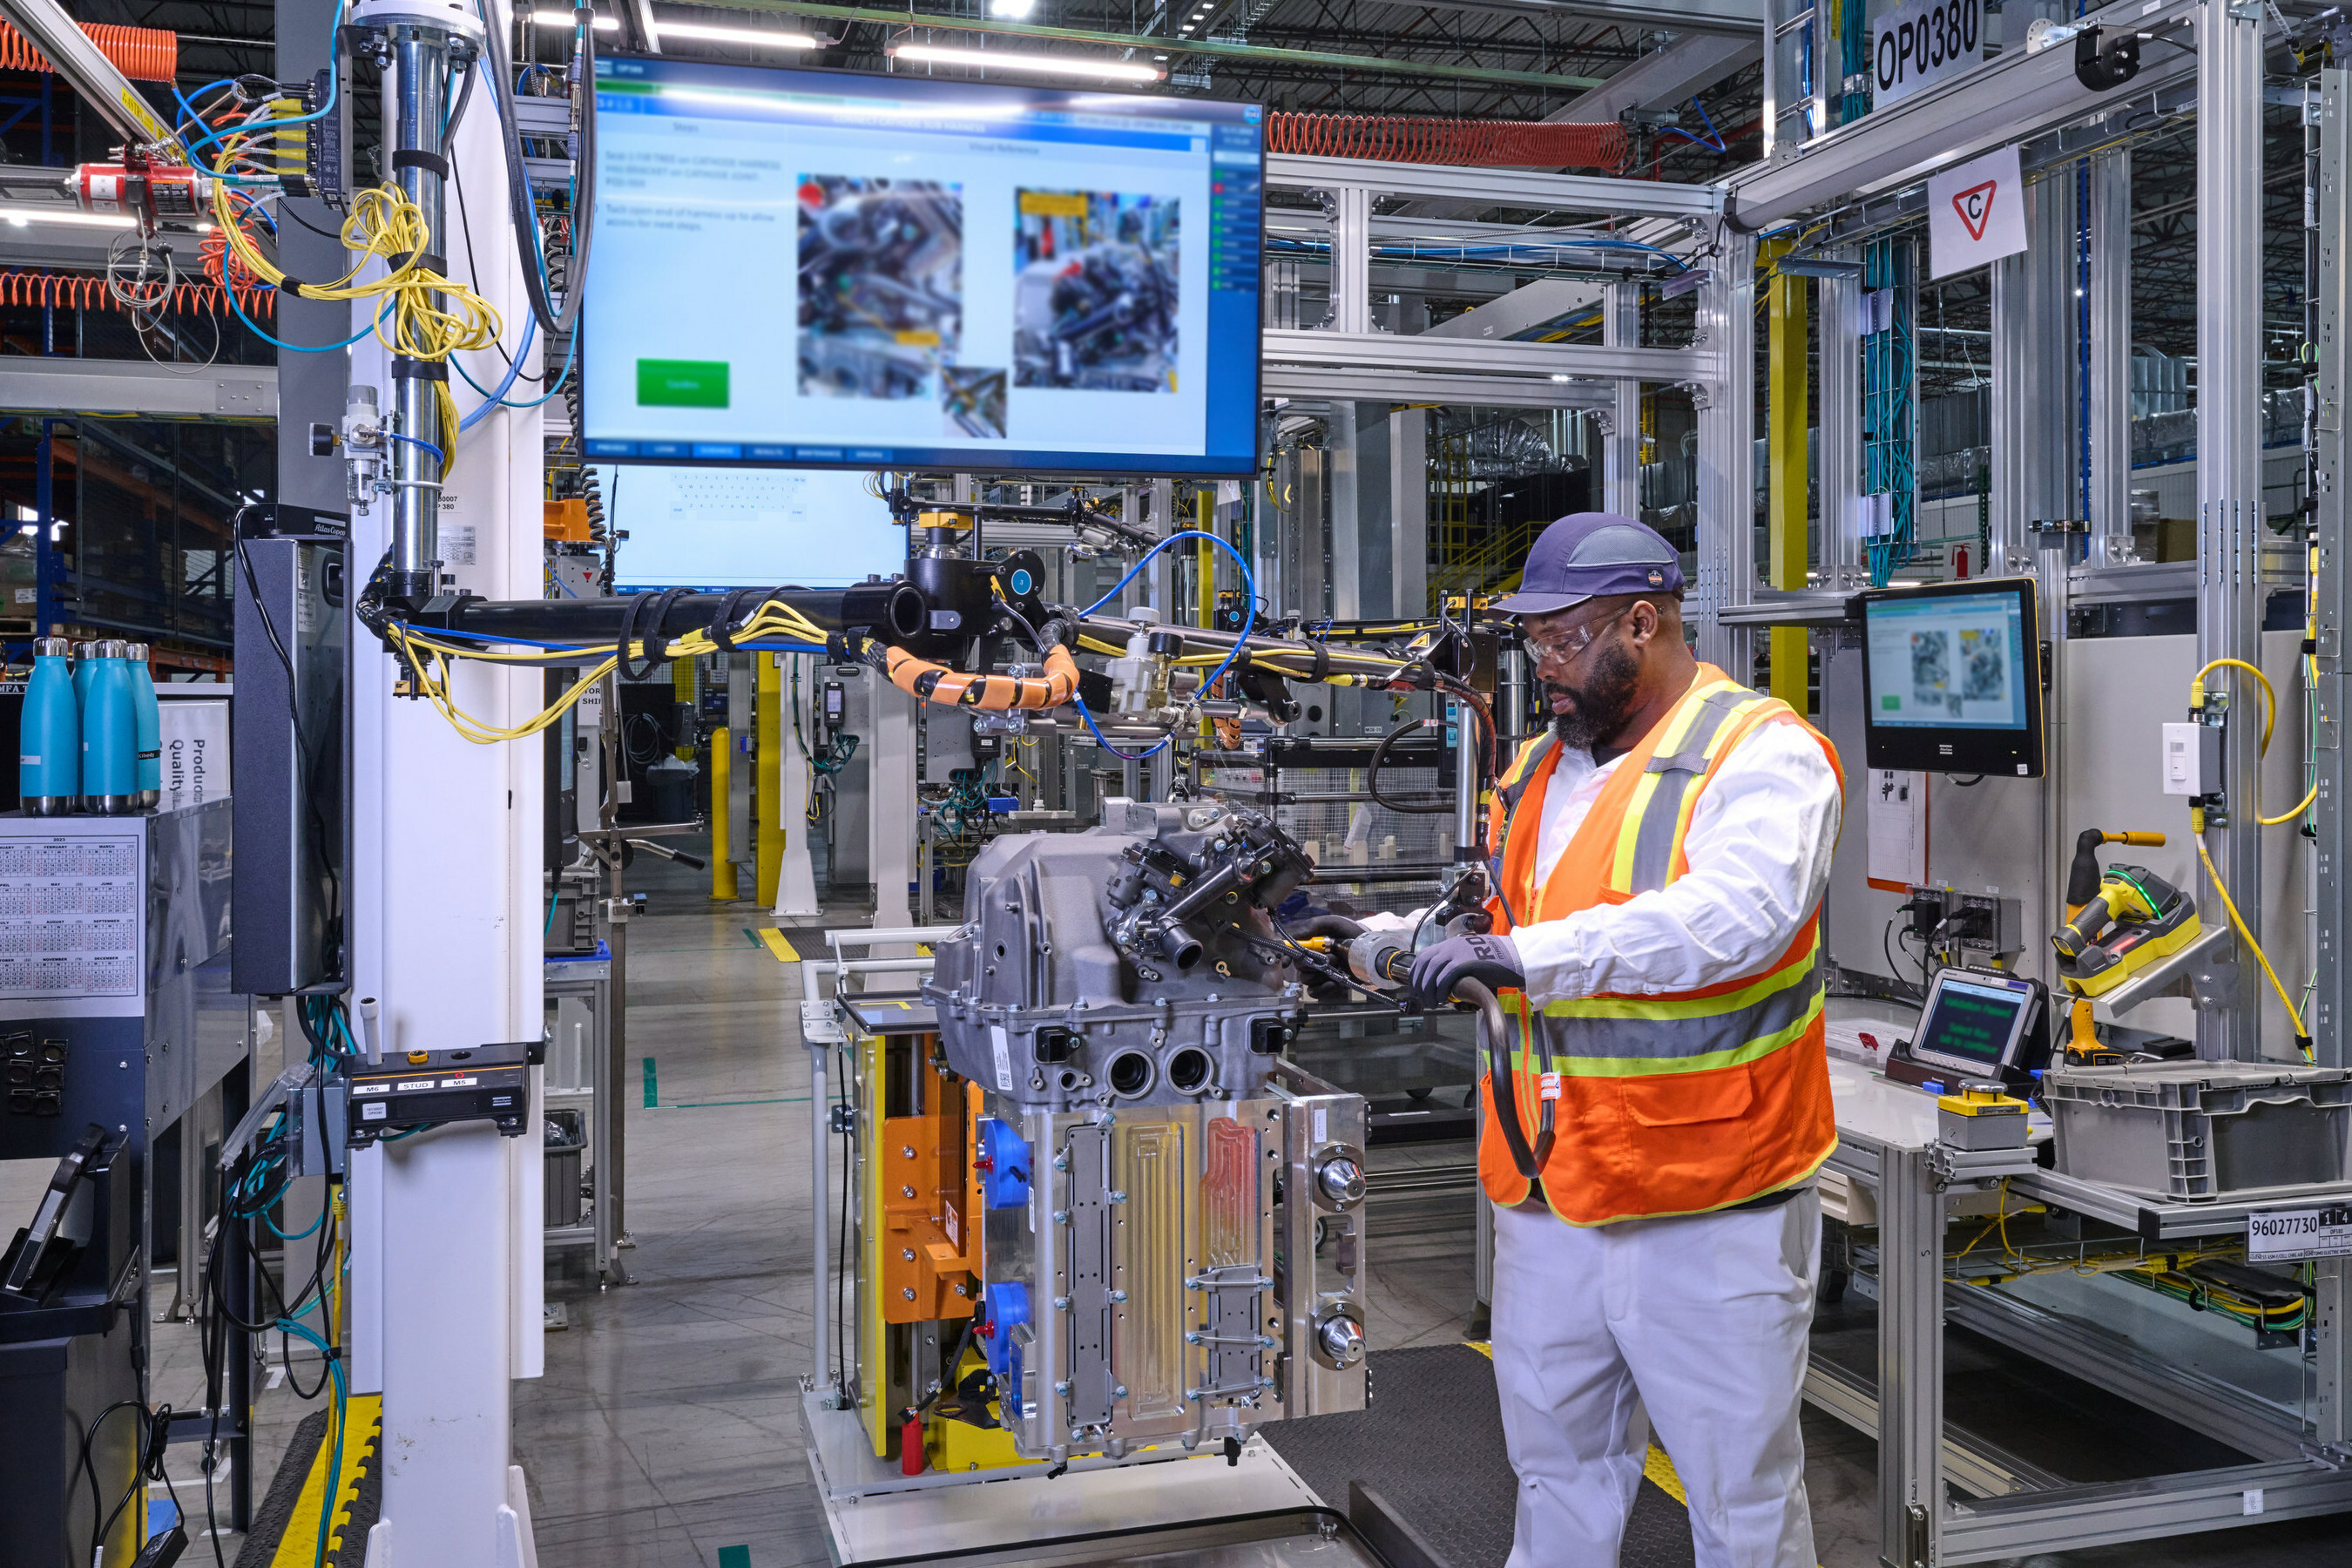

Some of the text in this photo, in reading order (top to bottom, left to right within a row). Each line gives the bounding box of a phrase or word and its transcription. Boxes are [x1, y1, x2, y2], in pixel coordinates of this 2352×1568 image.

[1877, 0, 1977, 91] OP0380
[1968, 193, 1983, 220] C
[2252, 1217, 2317, 1236] 96027730
[2325, 1213, 2331, 1225] 1
[2342, 1212, 2349, 1223] 4
